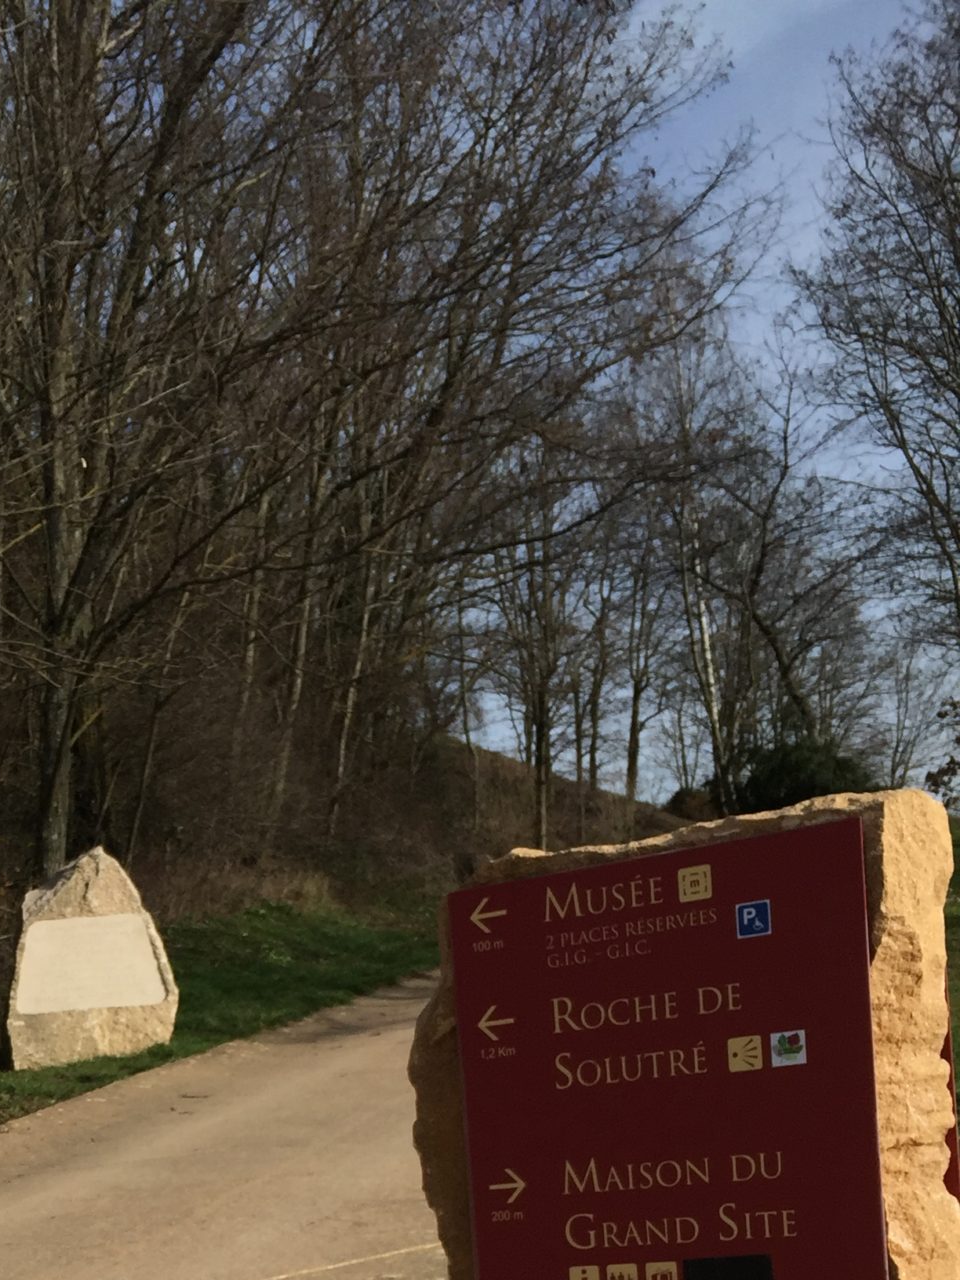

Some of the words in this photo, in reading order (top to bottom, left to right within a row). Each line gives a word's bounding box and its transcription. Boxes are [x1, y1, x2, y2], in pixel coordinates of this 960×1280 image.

[472, 940, 490, 952] 100
[494, 939, 504, 950] m
[546, 936, 554, 950] 2
[560, 924, 619, 948] PLACES
[551, 990, 679, 1035] ROCHE
[697, 982, 743, 1015] DE
[497, 1044, 516, 1056] Km
[554, 1040, 708, 1090] SOLUTRÉ
[562, 1157, 710, 1196] MAISON
[731, 1152, 783, 1183] DU
[491, 1209, 510, 1222] 200
[513, 1210, 524, 1220] m
[565, 1213, 700, 1250] GRAND
[718, 1202, 799, 1242] SITE
